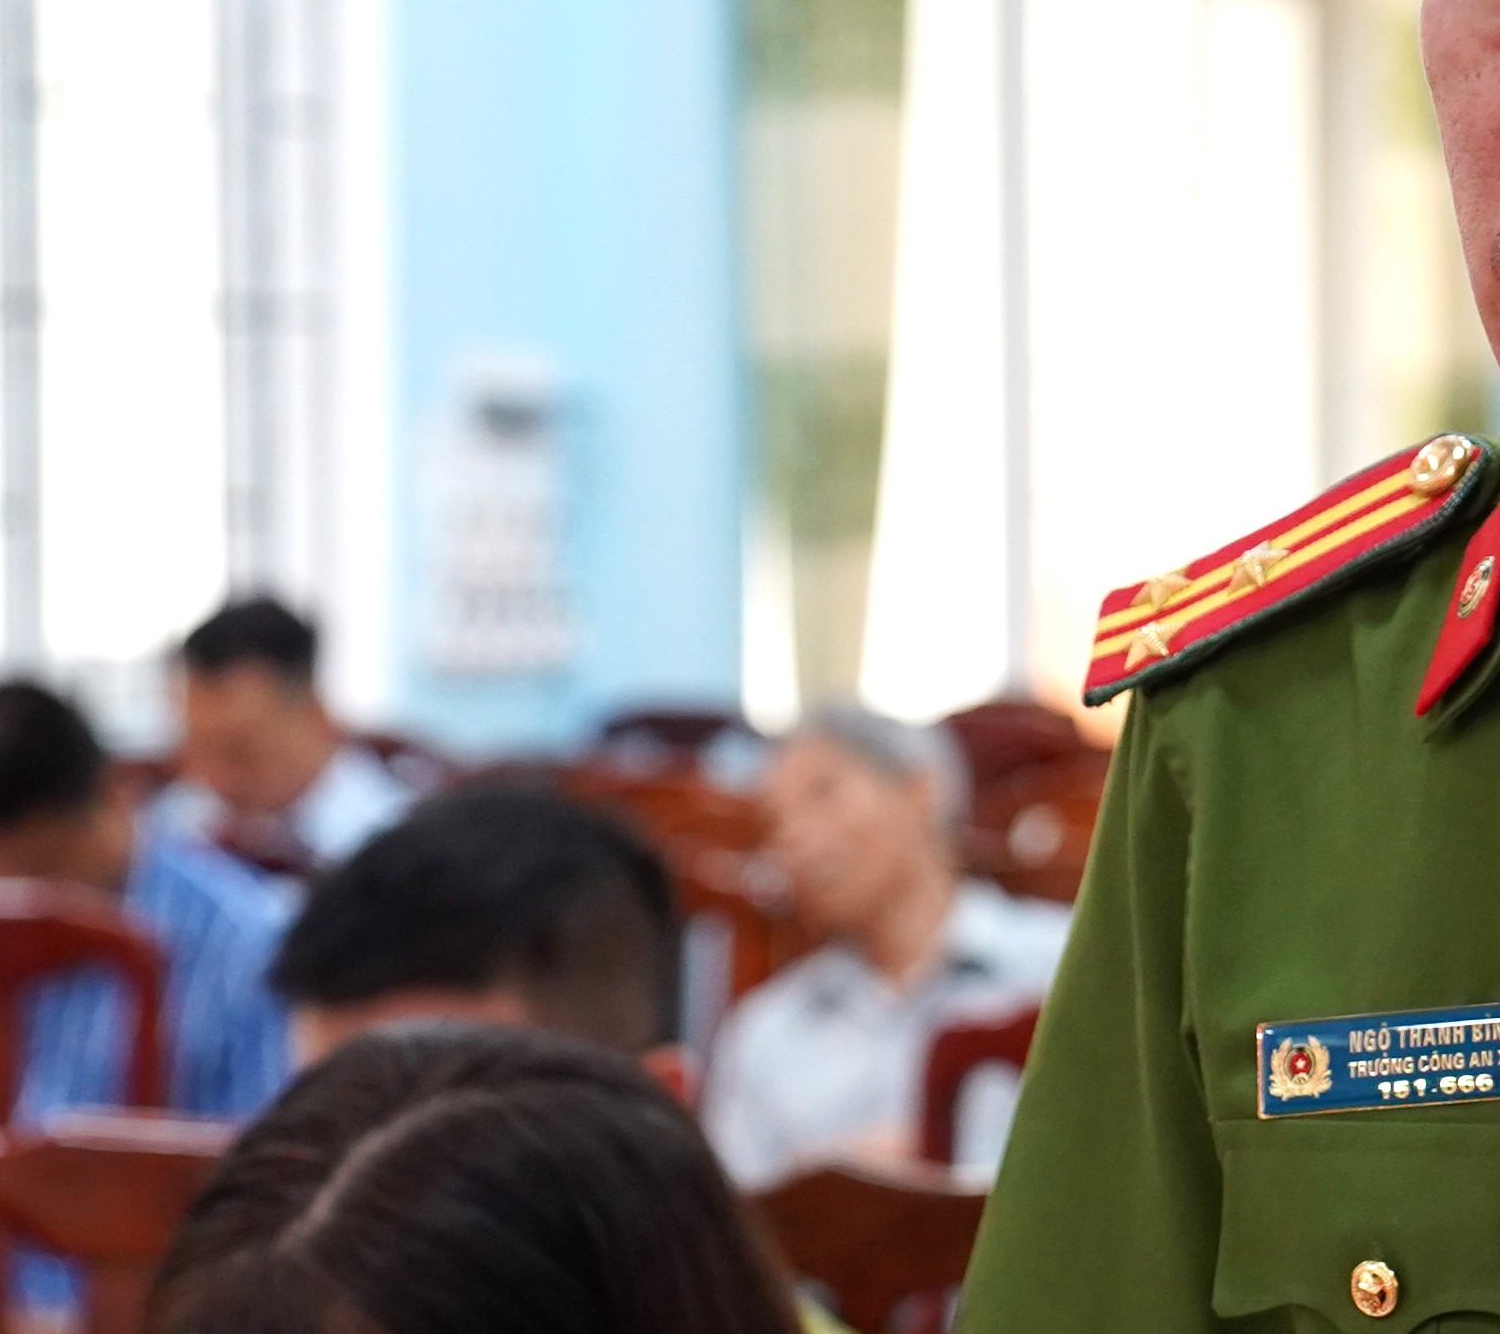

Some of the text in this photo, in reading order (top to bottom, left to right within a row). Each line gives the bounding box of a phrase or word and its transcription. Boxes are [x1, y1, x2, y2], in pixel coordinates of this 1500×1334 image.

[1397, 1023, 1466, 1049] THANH
[1417, 1049, 1466, 1073] CÔNG
[1468, 1049, 1494, 1068] AN
[1377, 1073, 1495, 1100] 151.666
